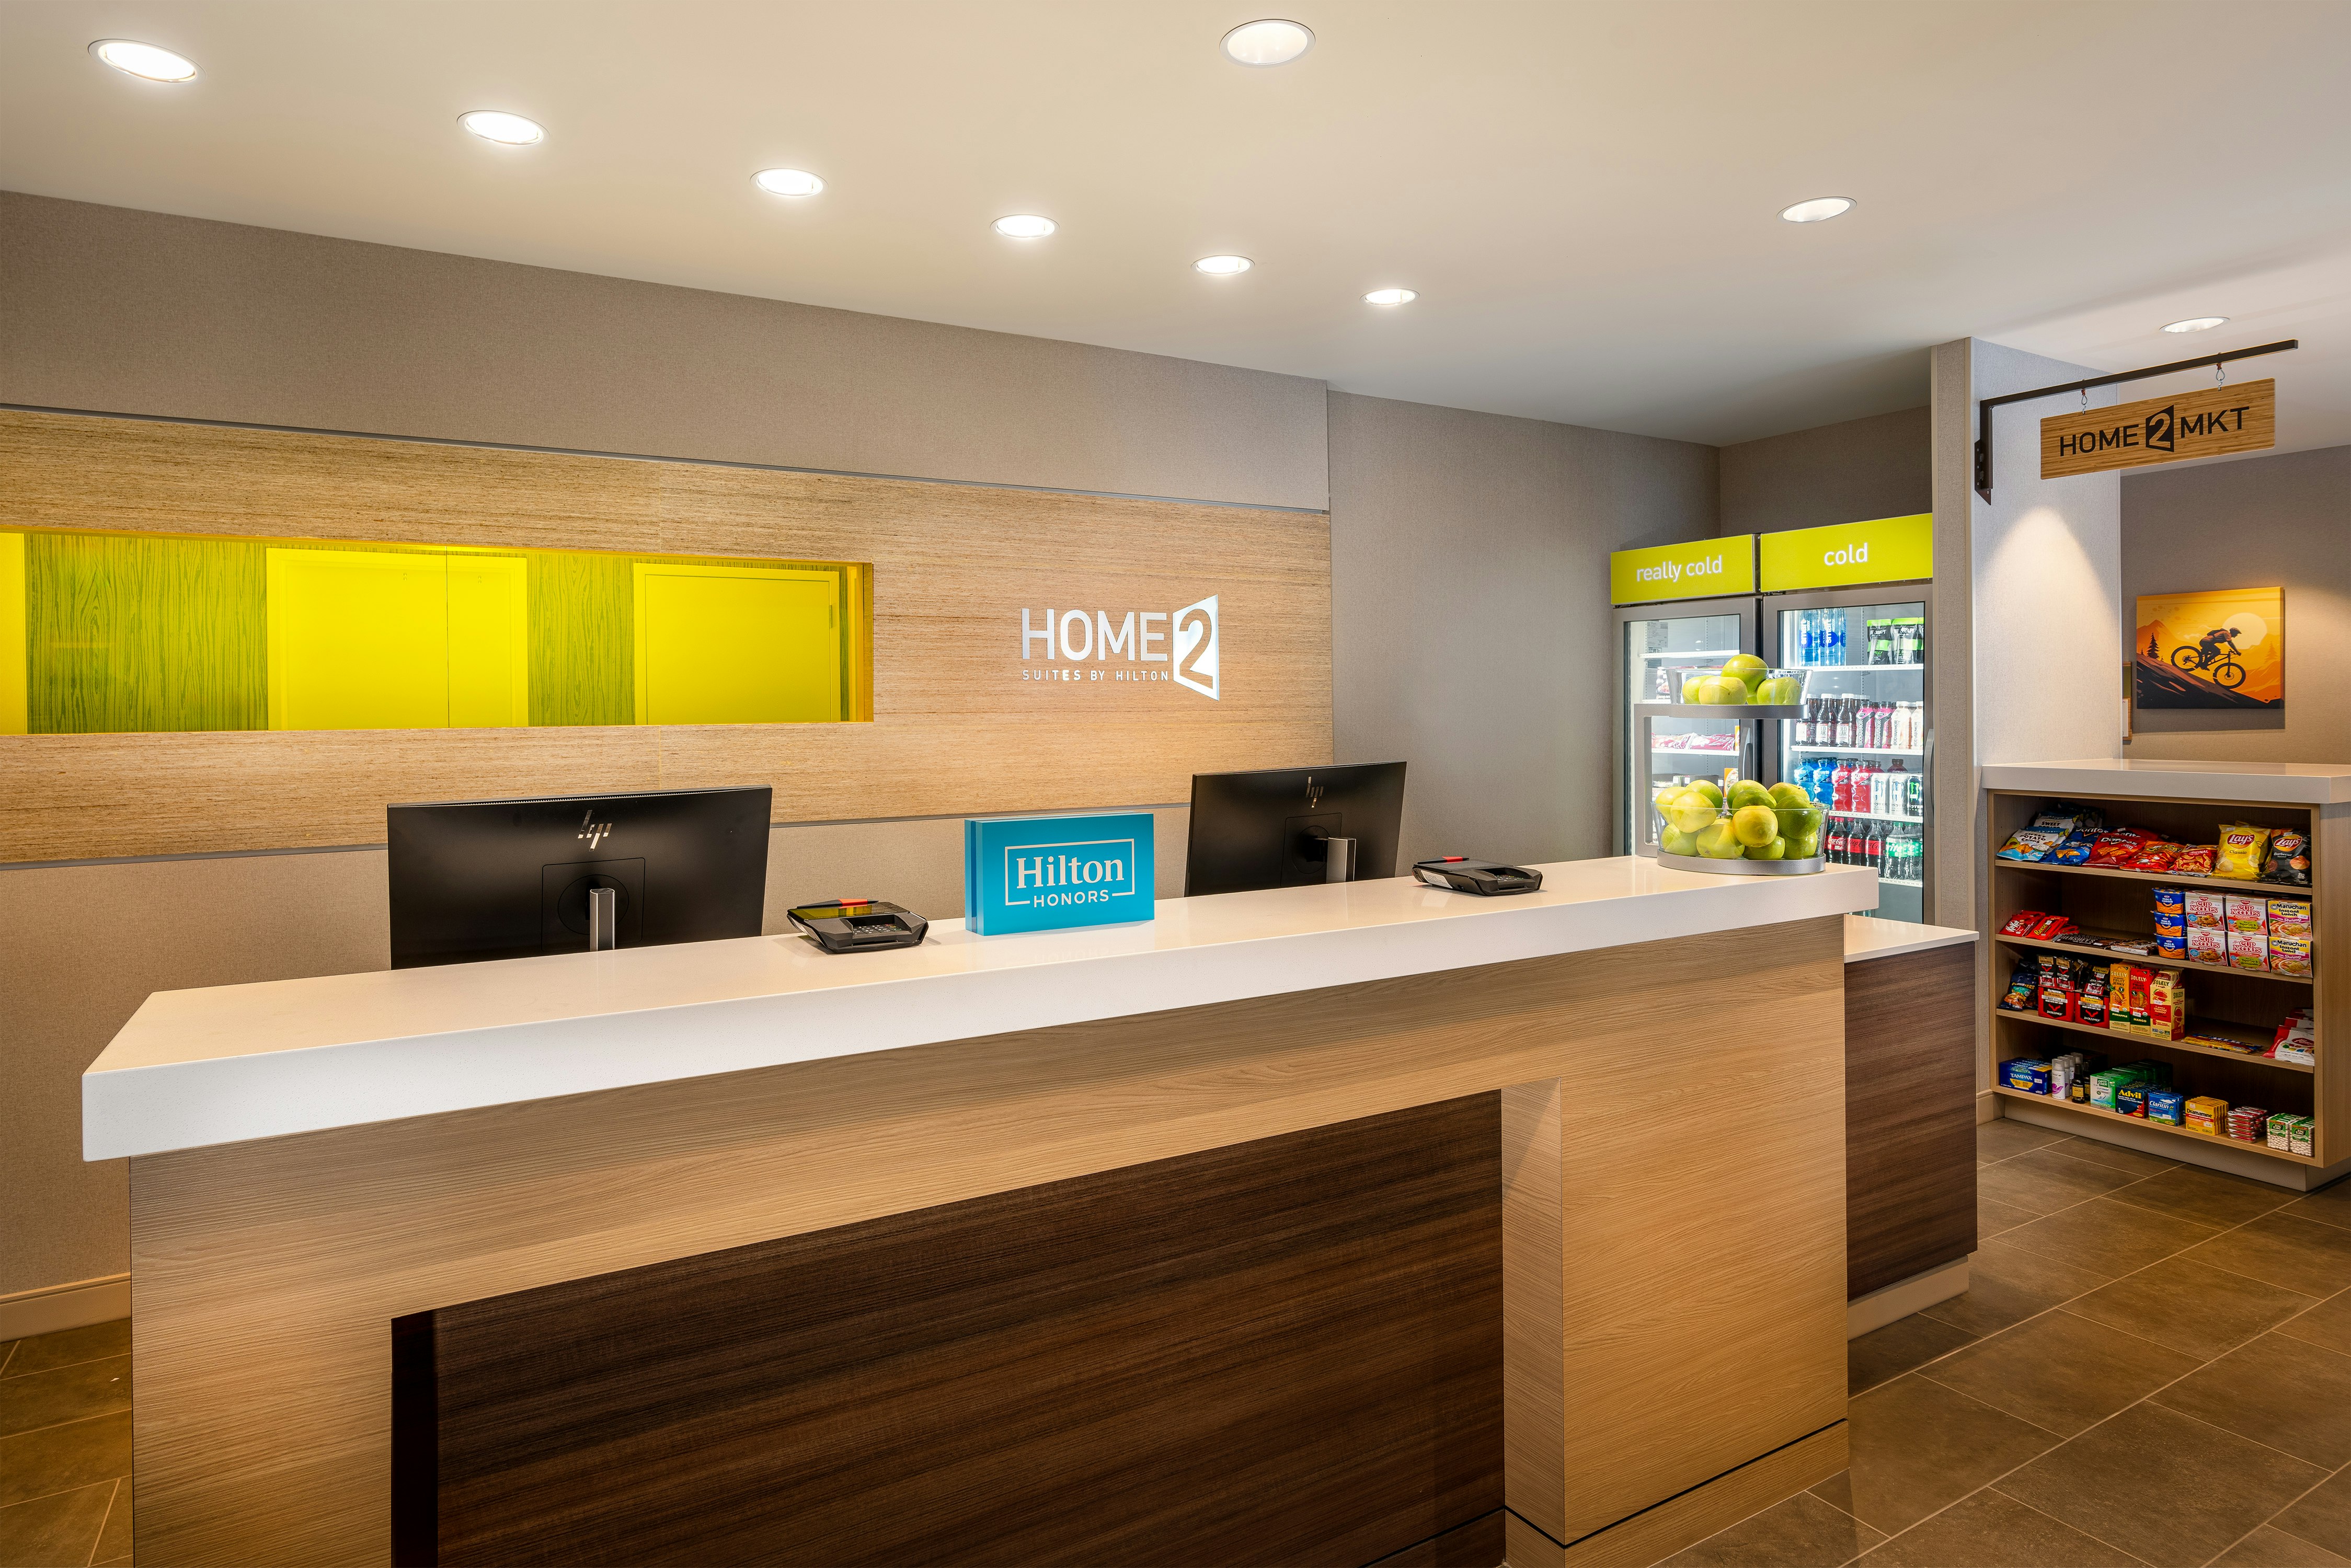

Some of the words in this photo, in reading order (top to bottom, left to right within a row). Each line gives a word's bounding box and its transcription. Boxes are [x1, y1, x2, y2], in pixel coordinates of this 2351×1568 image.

[2181, 406, 2249, 439] MKT
[1824, 543, 1868, 566] cold
[1636, 561, 1681, 582] really
[1686, 555, 1723, 576] cold
[1022, 670, 1081, 681] SUITES
[1091, 671, 1105, 681] BY
[1115, 671, 1168, 681] HILTON
[1305, 776, 1324, 808] hp
[577, 809, 613, 852] hp
[2228, 834, 2254, 845] Lay's
[2275, 838, 2299, 848] Lay's
[1016, 855, 1125, 889] Hilton
[1034, 890, 1109, 908] HONORS
[2189, 905, 2218, 913] NOODLES
[2230, 908, 2260, 917] NOODLES
[2034, 923, 2048, 936] Reese
[2233, 944, 2262, 953] NOODLES
[2118, 1089, 2141, 1099] Advil
[2149, 1100, 2169, 1109] Claritin
[2186, 1109, 2212, 1118] Dramamine
